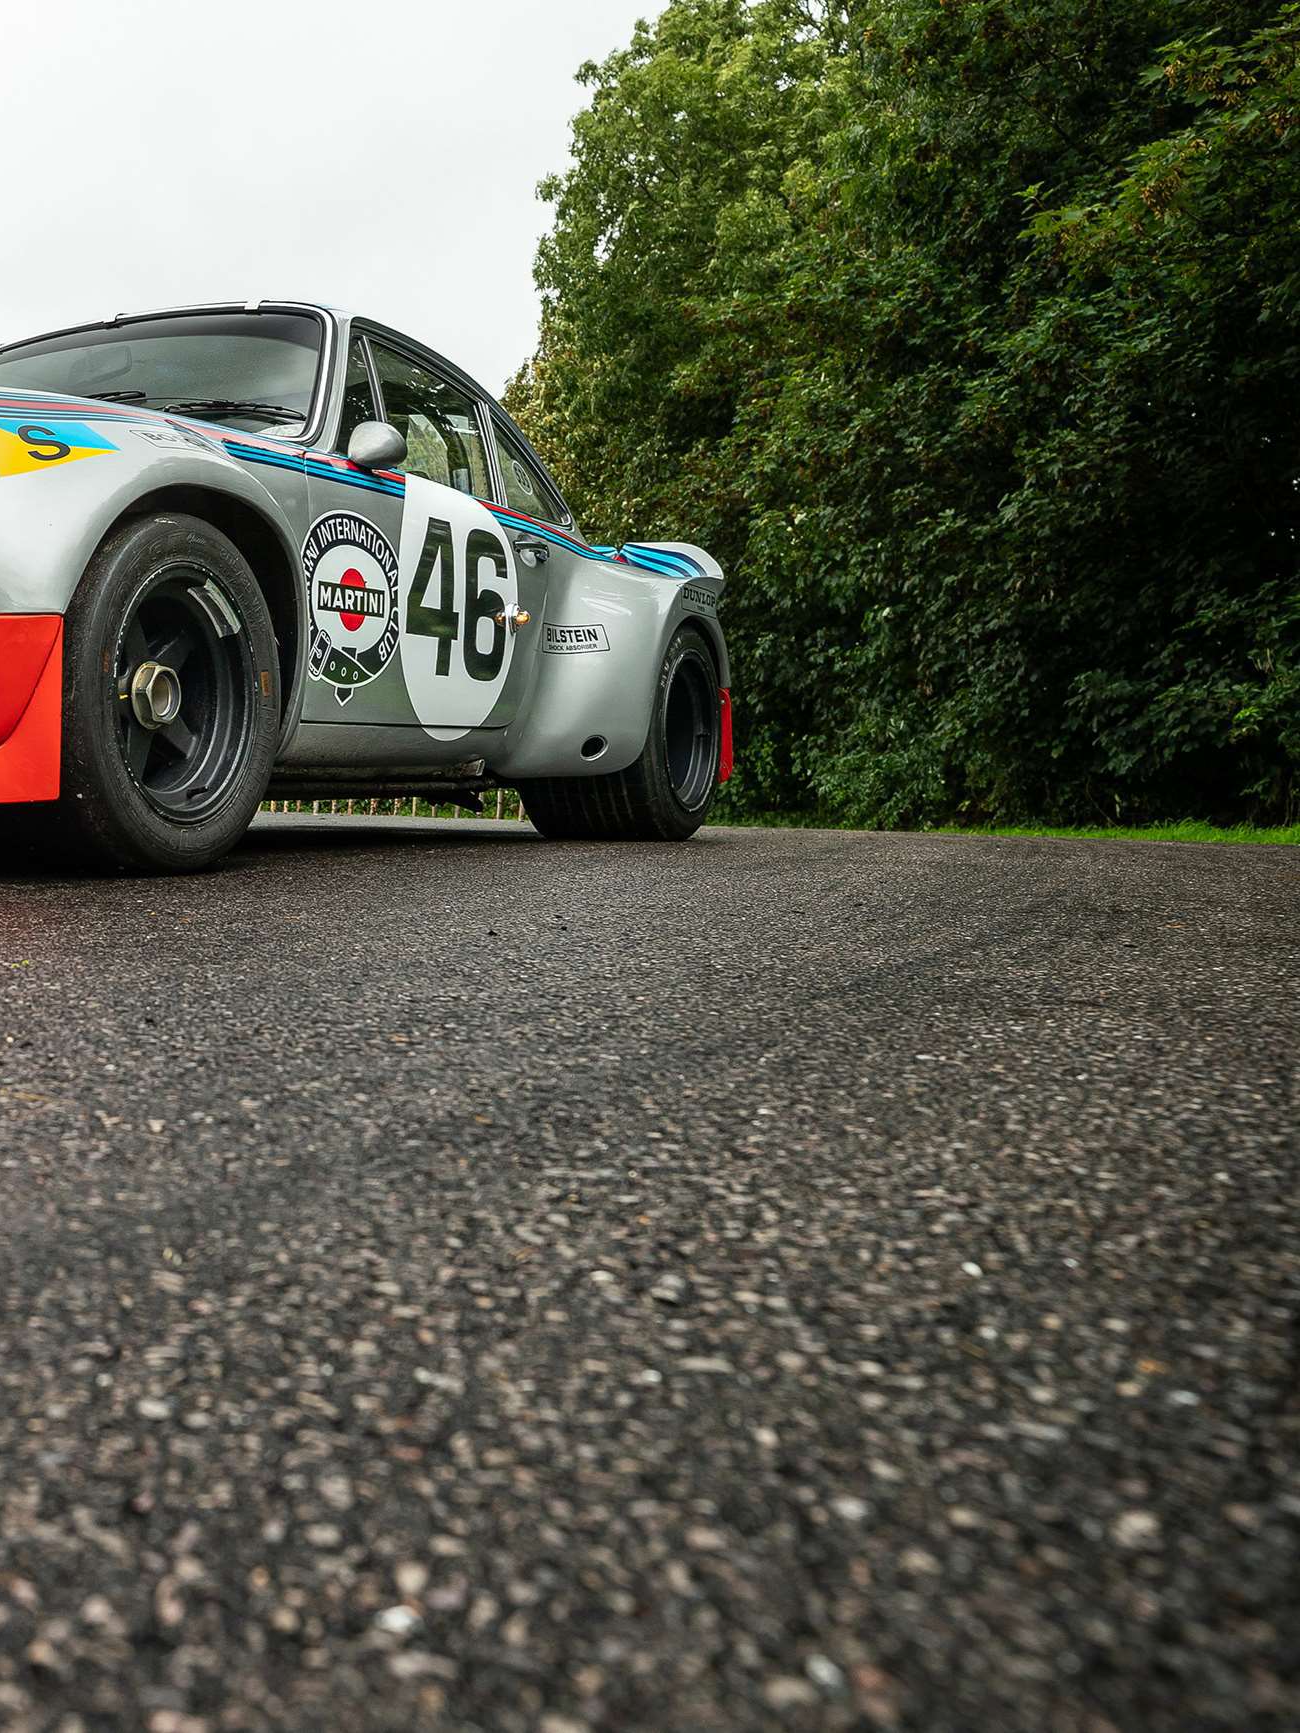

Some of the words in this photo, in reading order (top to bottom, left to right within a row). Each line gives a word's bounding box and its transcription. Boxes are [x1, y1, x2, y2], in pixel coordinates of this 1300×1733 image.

[17, 424, 71, 461] S
[316, 517, 399, 600] INTERNATIONAL
[378, 605, 399, 662] CLUB
[319, 584, 385, 615] MARTINI
[405, 516, 508, 683] 46
[683, 587, 716, 608] DUNLOP
[546, 627, 599, 643] BILSTEIN
